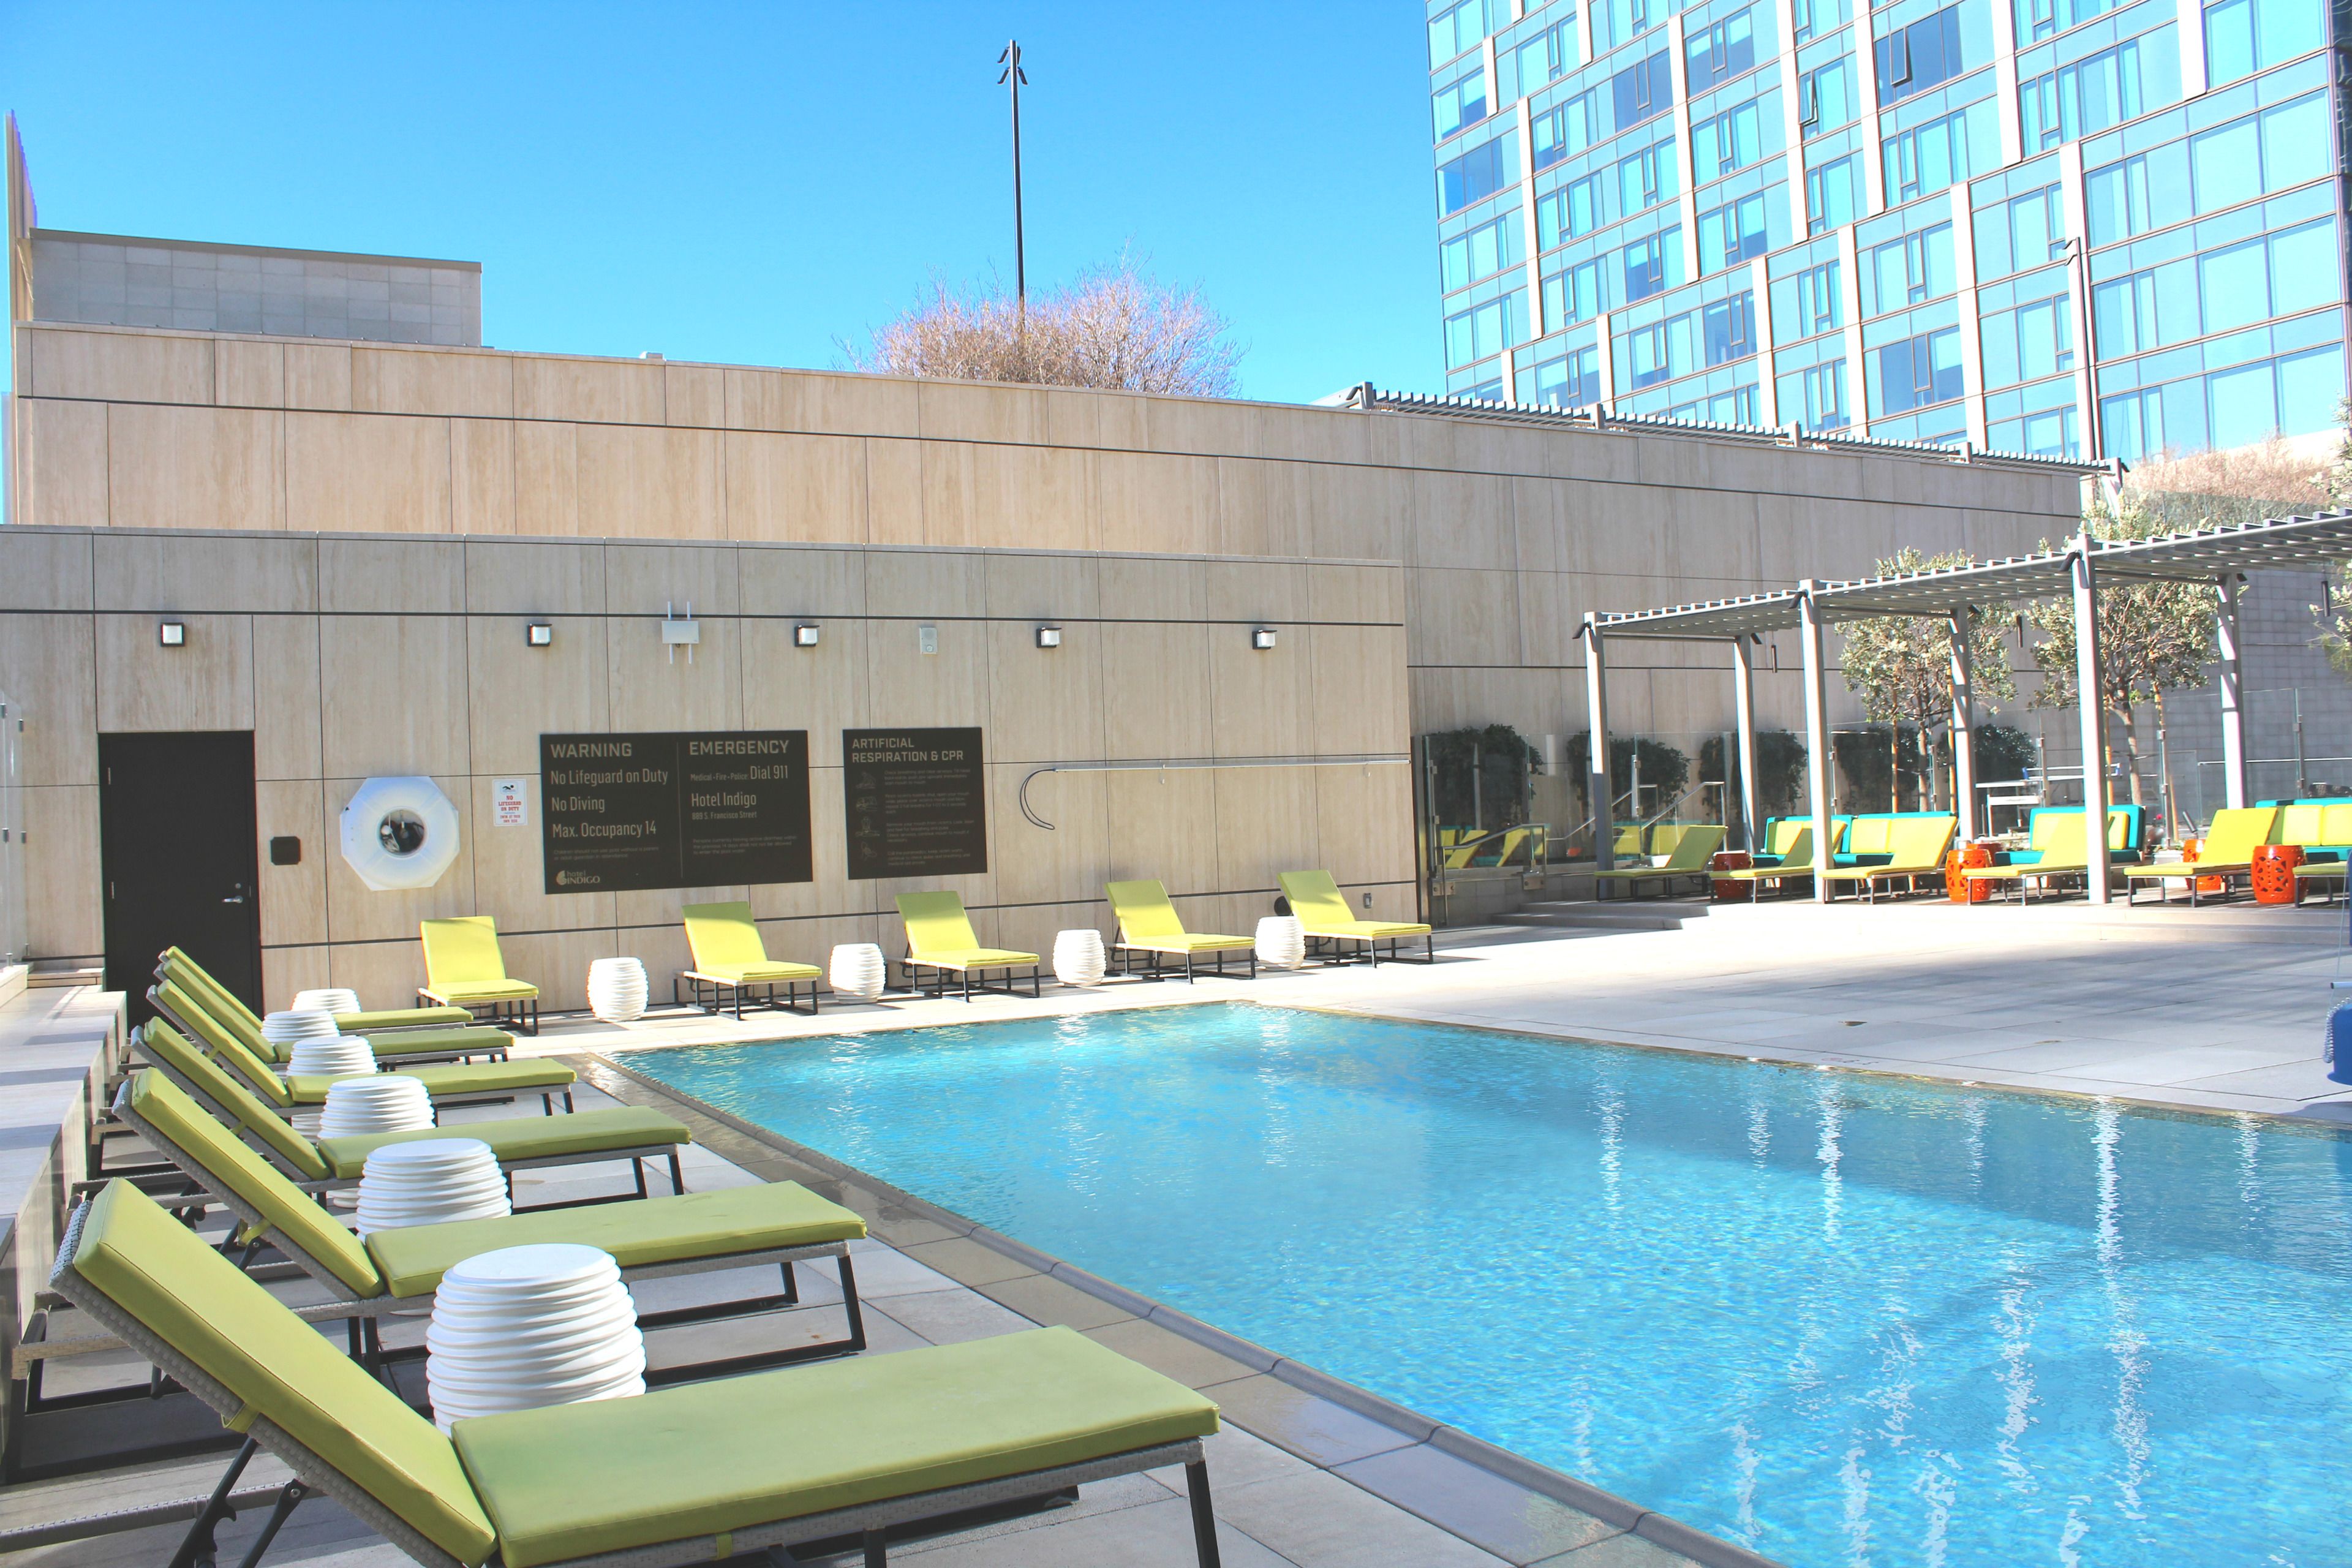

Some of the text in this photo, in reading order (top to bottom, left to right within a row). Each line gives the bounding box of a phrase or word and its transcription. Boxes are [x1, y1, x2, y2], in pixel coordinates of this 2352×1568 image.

[550, 742, 633, 758] WARNING
[689, 739, 790, 755] EMERGENCY
[852, 737, 914, 748] ARTIFICIAL
[852, 750, 964, 763] RESPIRATION & CPR
[551, 768, 668, 787] No Lifeguard on Duty
[750, 766, 771, 780] Dial
[773, 765, 788, 779] 911
[551, 796, 605, 813] No Diving
[691, 791, 757, 809] Hotel Indigo
[739, 810, 757, 819] Street
[552, 820, 657, 839] Max. Occupancy 14
[567, 876, 600, 884] INDIGO
